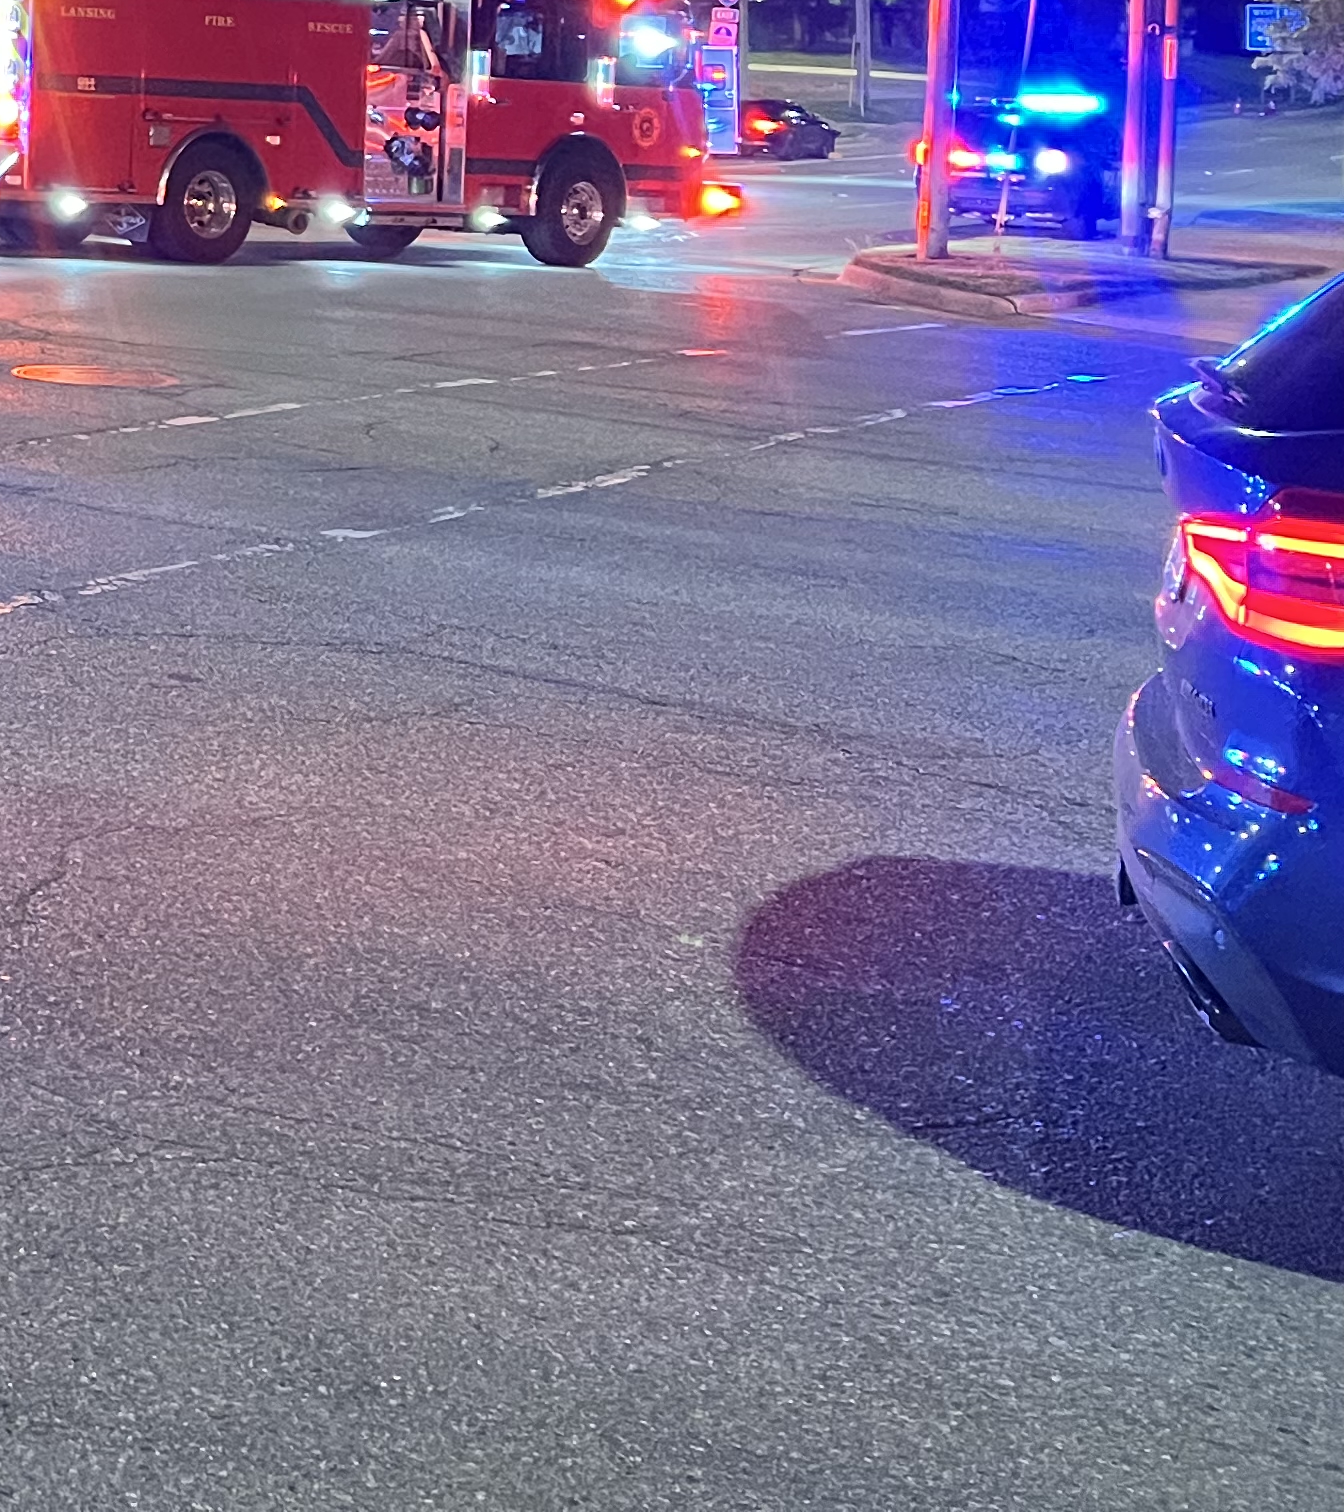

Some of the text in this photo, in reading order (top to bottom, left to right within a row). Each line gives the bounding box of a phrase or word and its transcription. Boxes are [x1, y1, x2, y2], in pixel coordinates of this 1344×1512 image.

[61, 5, 116, 20] LANSING
[205, 15, 235, 27] FIRE
[308, 21, 353, 34] RESCUE
